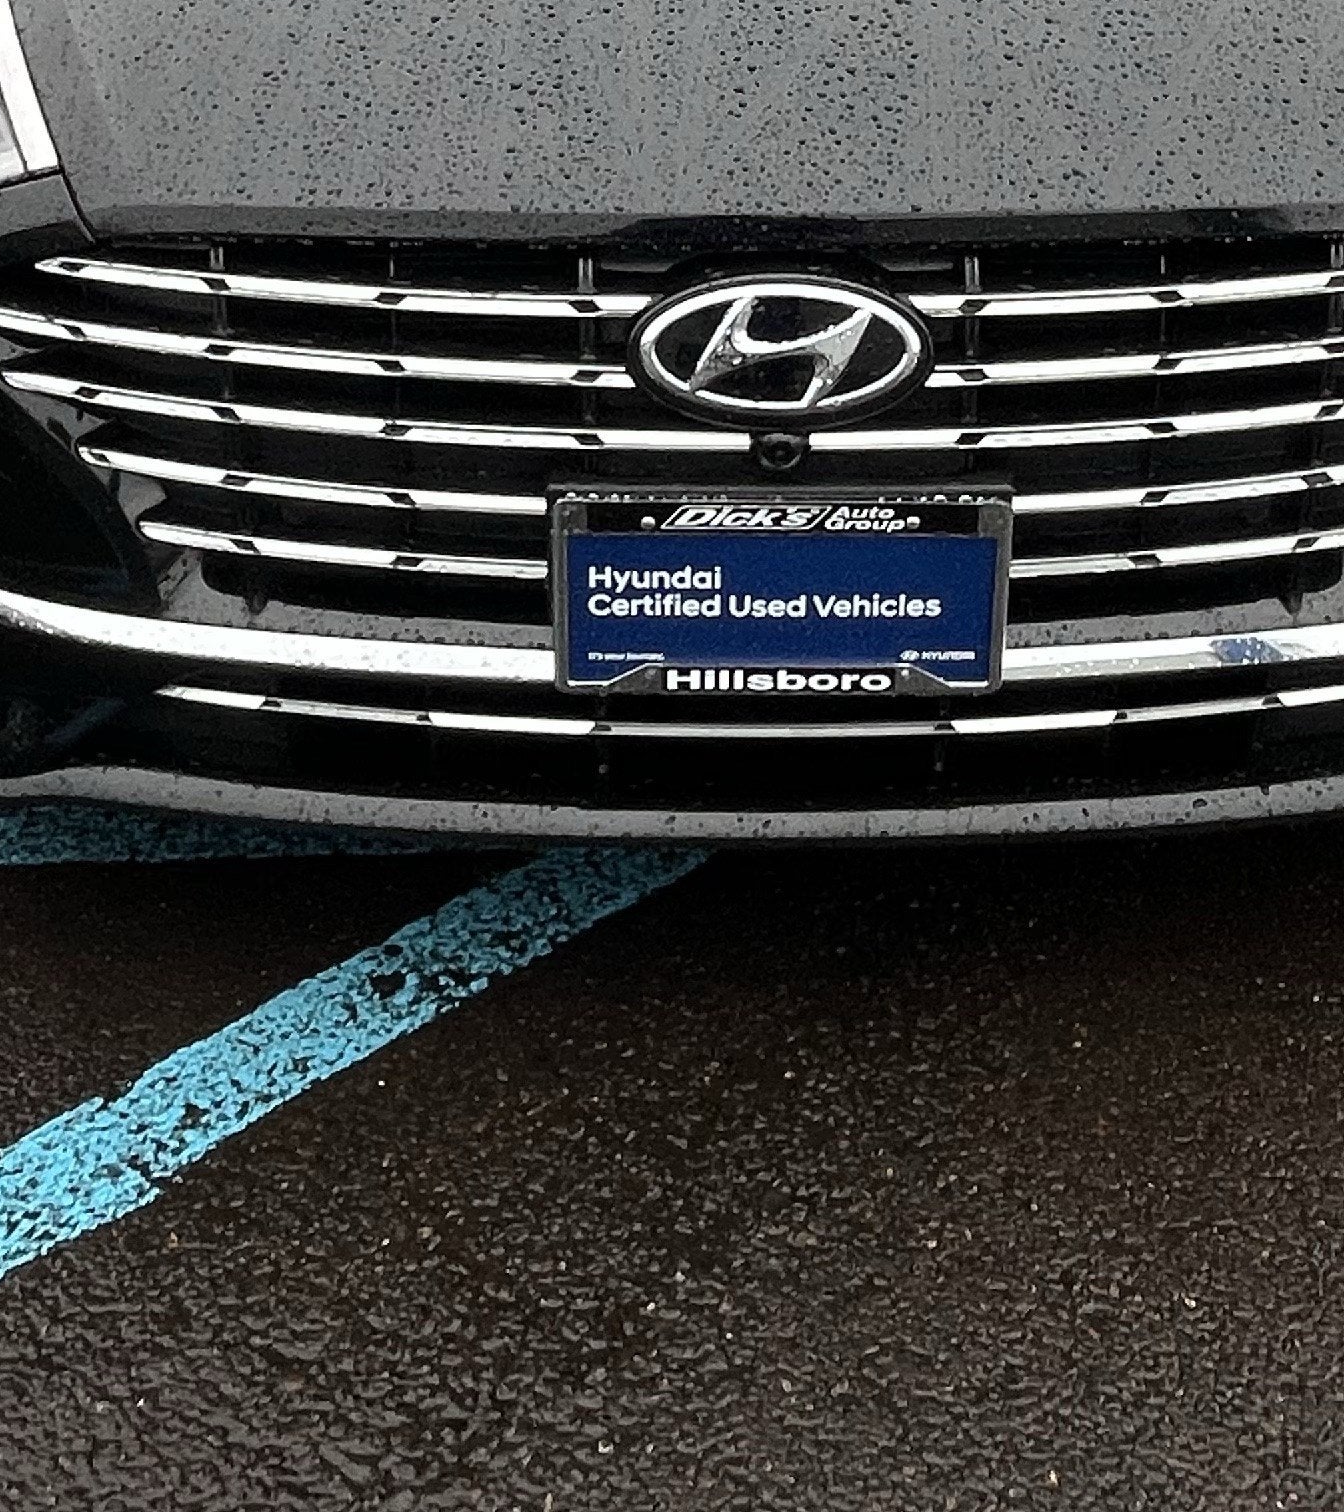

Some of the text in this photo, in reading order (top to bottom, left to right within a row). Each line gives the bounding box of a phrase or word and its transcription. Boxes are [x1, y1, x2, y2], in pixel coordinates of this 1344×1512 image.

[674, 506, 814, 529] Dick's
[834, 506, 895, 519] Auto
[824, 518, 906, 533] Group
[588, 565, 722, 593] Hyundai
[588, 593, 942, 618] Certified Used Vehicles
[666, 669, 892, 691] Hillsboro
